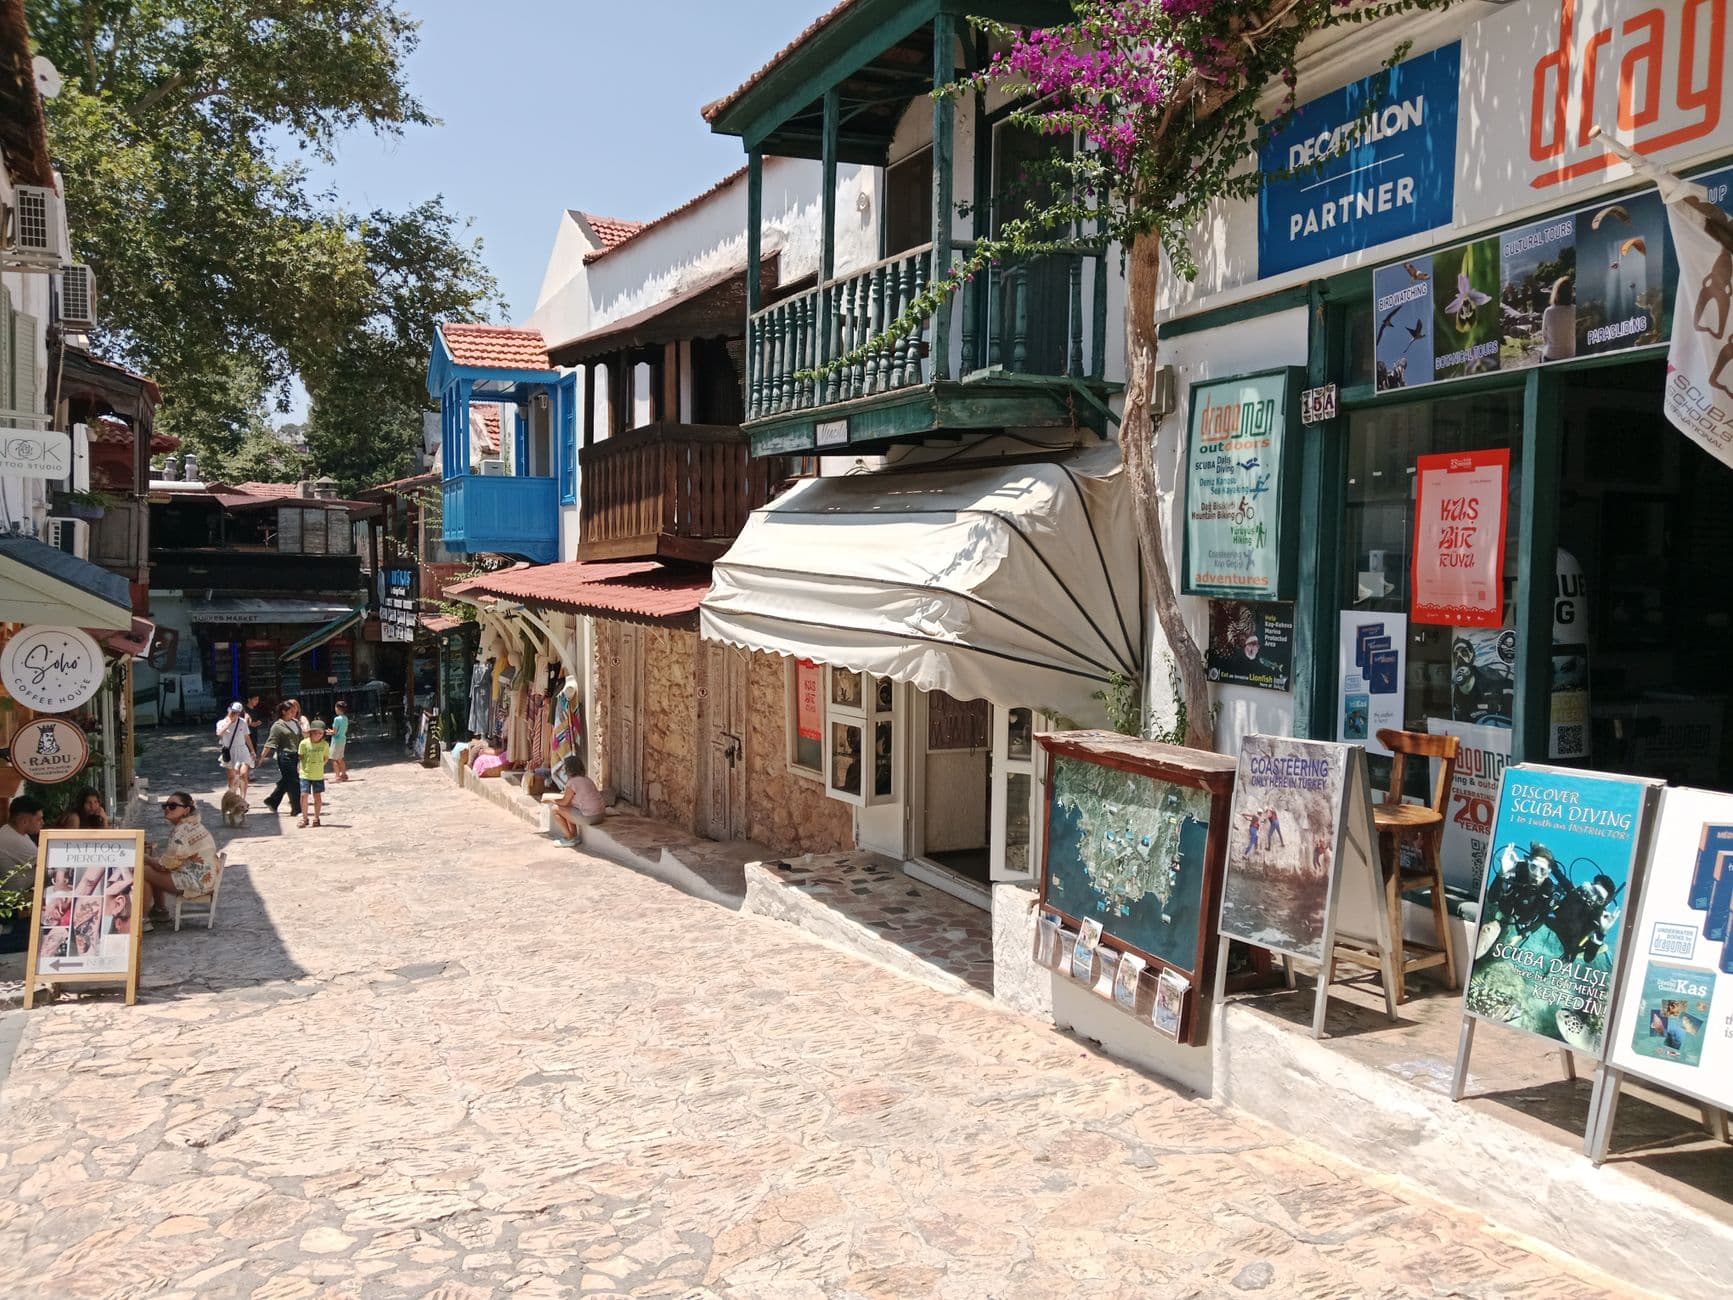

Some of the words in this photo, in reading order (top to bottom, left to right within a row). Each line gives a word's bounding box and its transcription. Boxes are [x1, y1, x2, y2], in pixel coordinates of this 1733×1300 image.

[1289, 95, 1424, 174] DECATHLON
[1709, 184, 1728, 204] UP
[1290, 176, 1414, 241] PARTNER
[1504, 232, 1544, 257] CULTURAL
[1544, 220, 1573, 243] TOURS
[1435, 349, 1473, 370] BOTANICAL
[1473, 340, 1498, 360] TOURS
[1201, 392, 1274, 442] dragoman
[1200, 439, 1271, 454] outdoors
[1195, 460, 1215, 471] SCUBA
[1216, 466, 1235, 474] Diving
[1192, 512, 1216, 520] Mountain
[1217, 511, 1235, 521] Biking
[1195, 571, 1269, 585] adventures
[24, 644, 78, 684] Soho
[15, 678, 53, 705] COFFEE
[59, 678, 91, 704] HOUSE
[29, 754, 71, 766] RADU
[1251, 757, 1329, 777] COASTEERING
[1251, 775, 1268, 787] ONLY
[1298, 778, 1328, 791] TURKEY
[1511, 784, 1579, 804] DISCOVER
[1454, 793, 1495, 826] 20
[1511, 798, 1562, 818] SCUBA
[1569, 806, 1632, 830] DIVING
[1459, 820, 1490, 835] YEARS
[63, 841, 121, 853] TATTOO
[66, 854, 115, 863] PIERCING
[1493, 943, 1544, 968] SCUBA
[1550, 959, 1608, 988] DALIŞI
